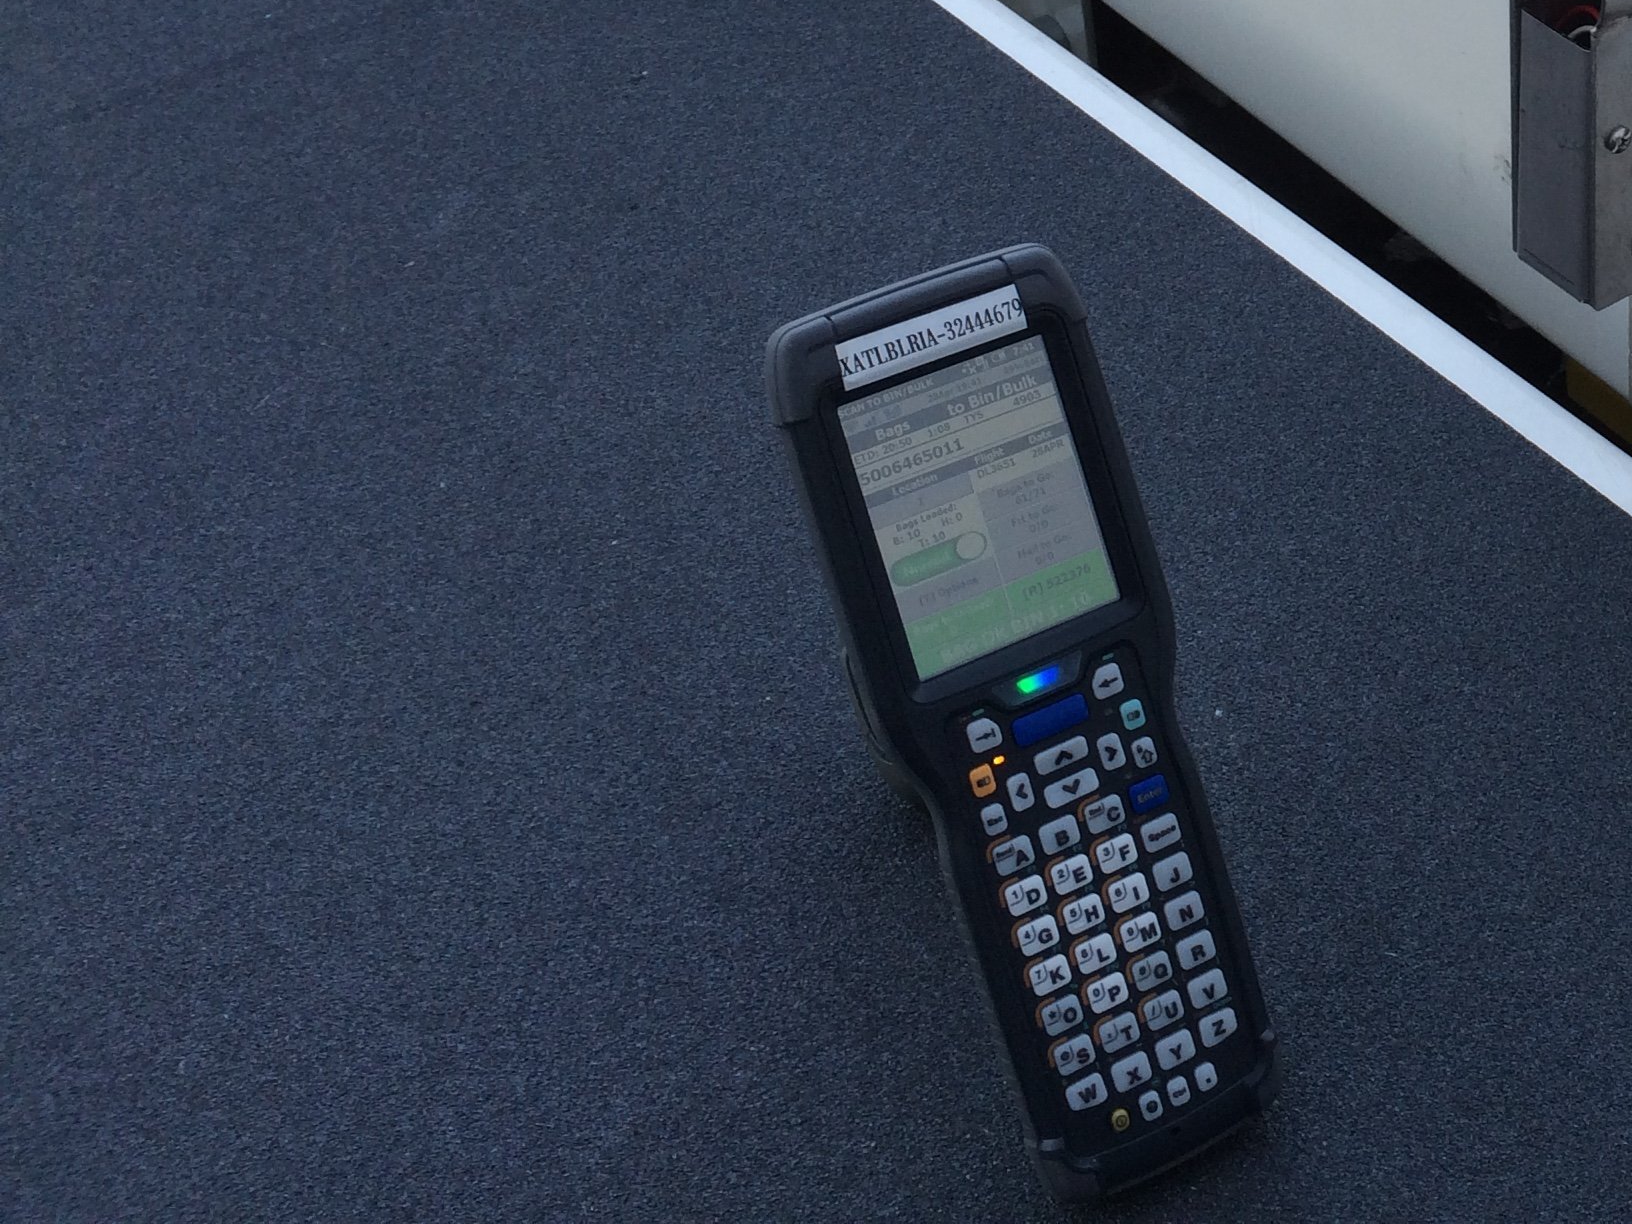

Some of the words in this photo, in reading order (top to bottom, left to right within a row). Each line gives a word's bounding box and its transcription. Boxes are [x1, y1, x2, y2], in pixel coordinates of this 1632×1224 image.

[838, 297, 1024, 378] XATLBLRIA-32444679
[866, 396, 881, 408] TO
[882, 377, 934, 403] BIN/BULK
[874, 418, 912, 443] Bags
[946, 399, 966, 417] to
[966, 372, 1038, 410] Bin/Bulk
[858, 436, 965, 487] 5006465011
[973, 445, 1006, 466] Flight
[1107, 806, 1121, 822] C
[1054, 829, 1070, 847] B
[1148, 824, 1176, 842] Space
[1015, 849, 1030, 867] A
[1102, 847, 1111, 857] 3
[1118, 844, 1130, 861] F
[1056, 869, 1066, 879] 2
[1072, 866, 1088, 883] E
[1169, 867, 1181, 883] J
[1011, 890, 1019, 900] 1
[1026, 888, 1041, 905] D
[1132, 886, 1140, 900] I
[1069, 906, 1078, 917] 5
[1085, 905, 1099, 922] H
[1178, 904, 1194, 922] N
[1024, 930, 1031, 940] 4
[1038, 928, 1053, 944] G
[1126, 927, 1135, 937] 9
[1139, 923, 1158, 942] M
[1096, 948, 1111, 963] L
[1190, 944, 1206, 961] R
[1035, 969, 1042, 980] 7
[1049, 965, 1066, 985] K
[1153, 963, 1168, 979] Q
[1092, 988, 1100, 998] 0
[1107, 984, 1121, 1002] P
[1201, 983, 1216, 999] V
[1062, 1008, 1078, 1024] O
[1164, 1001, 1179, 1018] U
[1119, 1025, 1133, 1041] T
[1212, 1020, 1226, 1037] Z
[1076, 1047, 1090, 1064] S
[1168, 1043, 1183, 1061] Y
[1126, 1066, 1142, 1084] X
[1078, 1083, 1097, 1104] W
